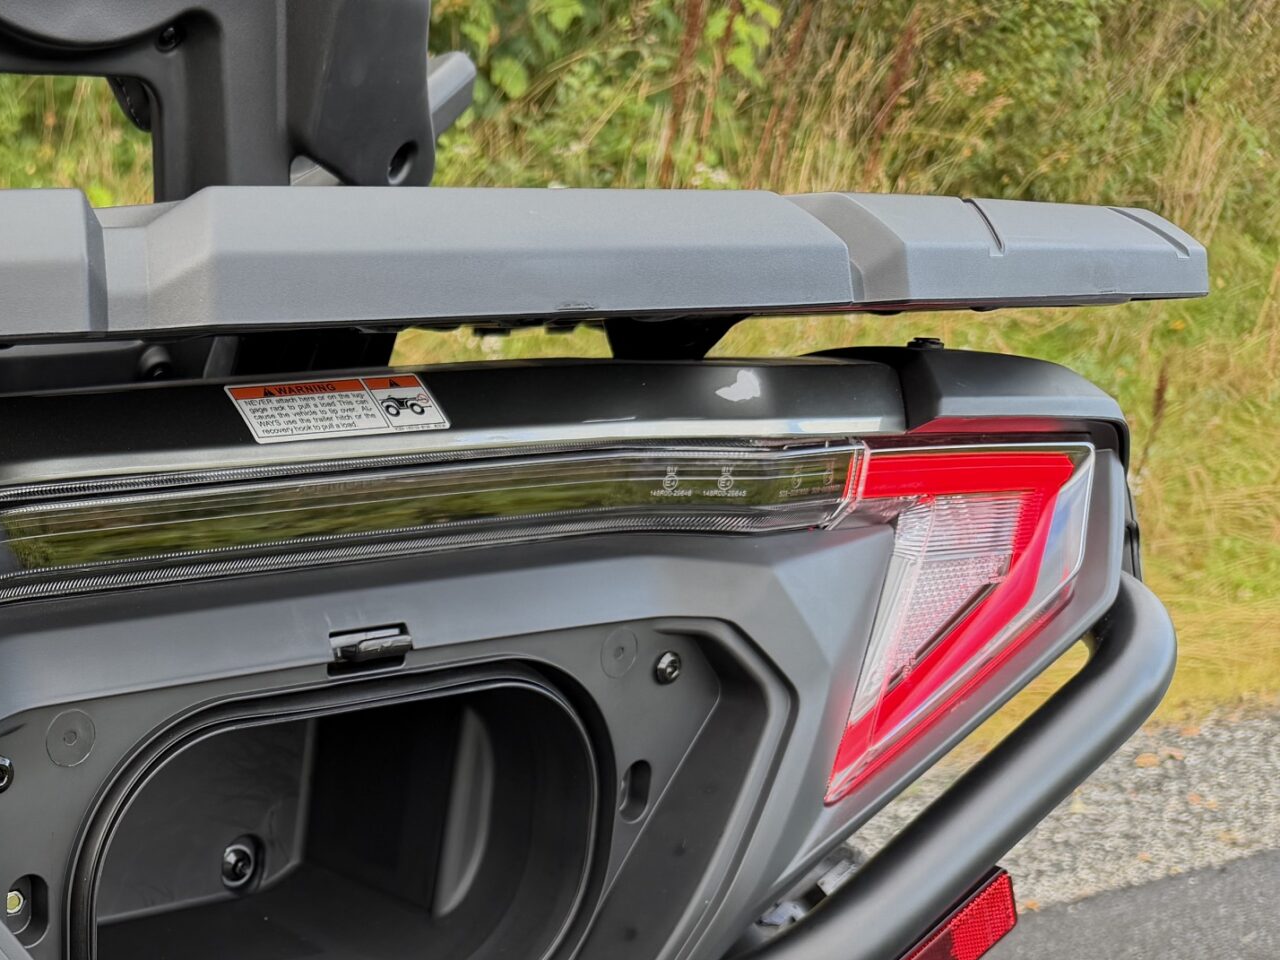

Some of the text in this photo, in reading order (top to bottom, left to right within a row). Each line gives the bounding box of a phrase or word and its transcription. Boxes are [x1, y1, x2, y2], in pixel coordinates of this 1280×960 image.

[275, 384, 336, 396] WARNING
[248, 407, 268, 415] gage
[297, 403, 311, 411] pull
[293, 409, 318, 417] vehicle
[321, 422, 335, 431] pull
